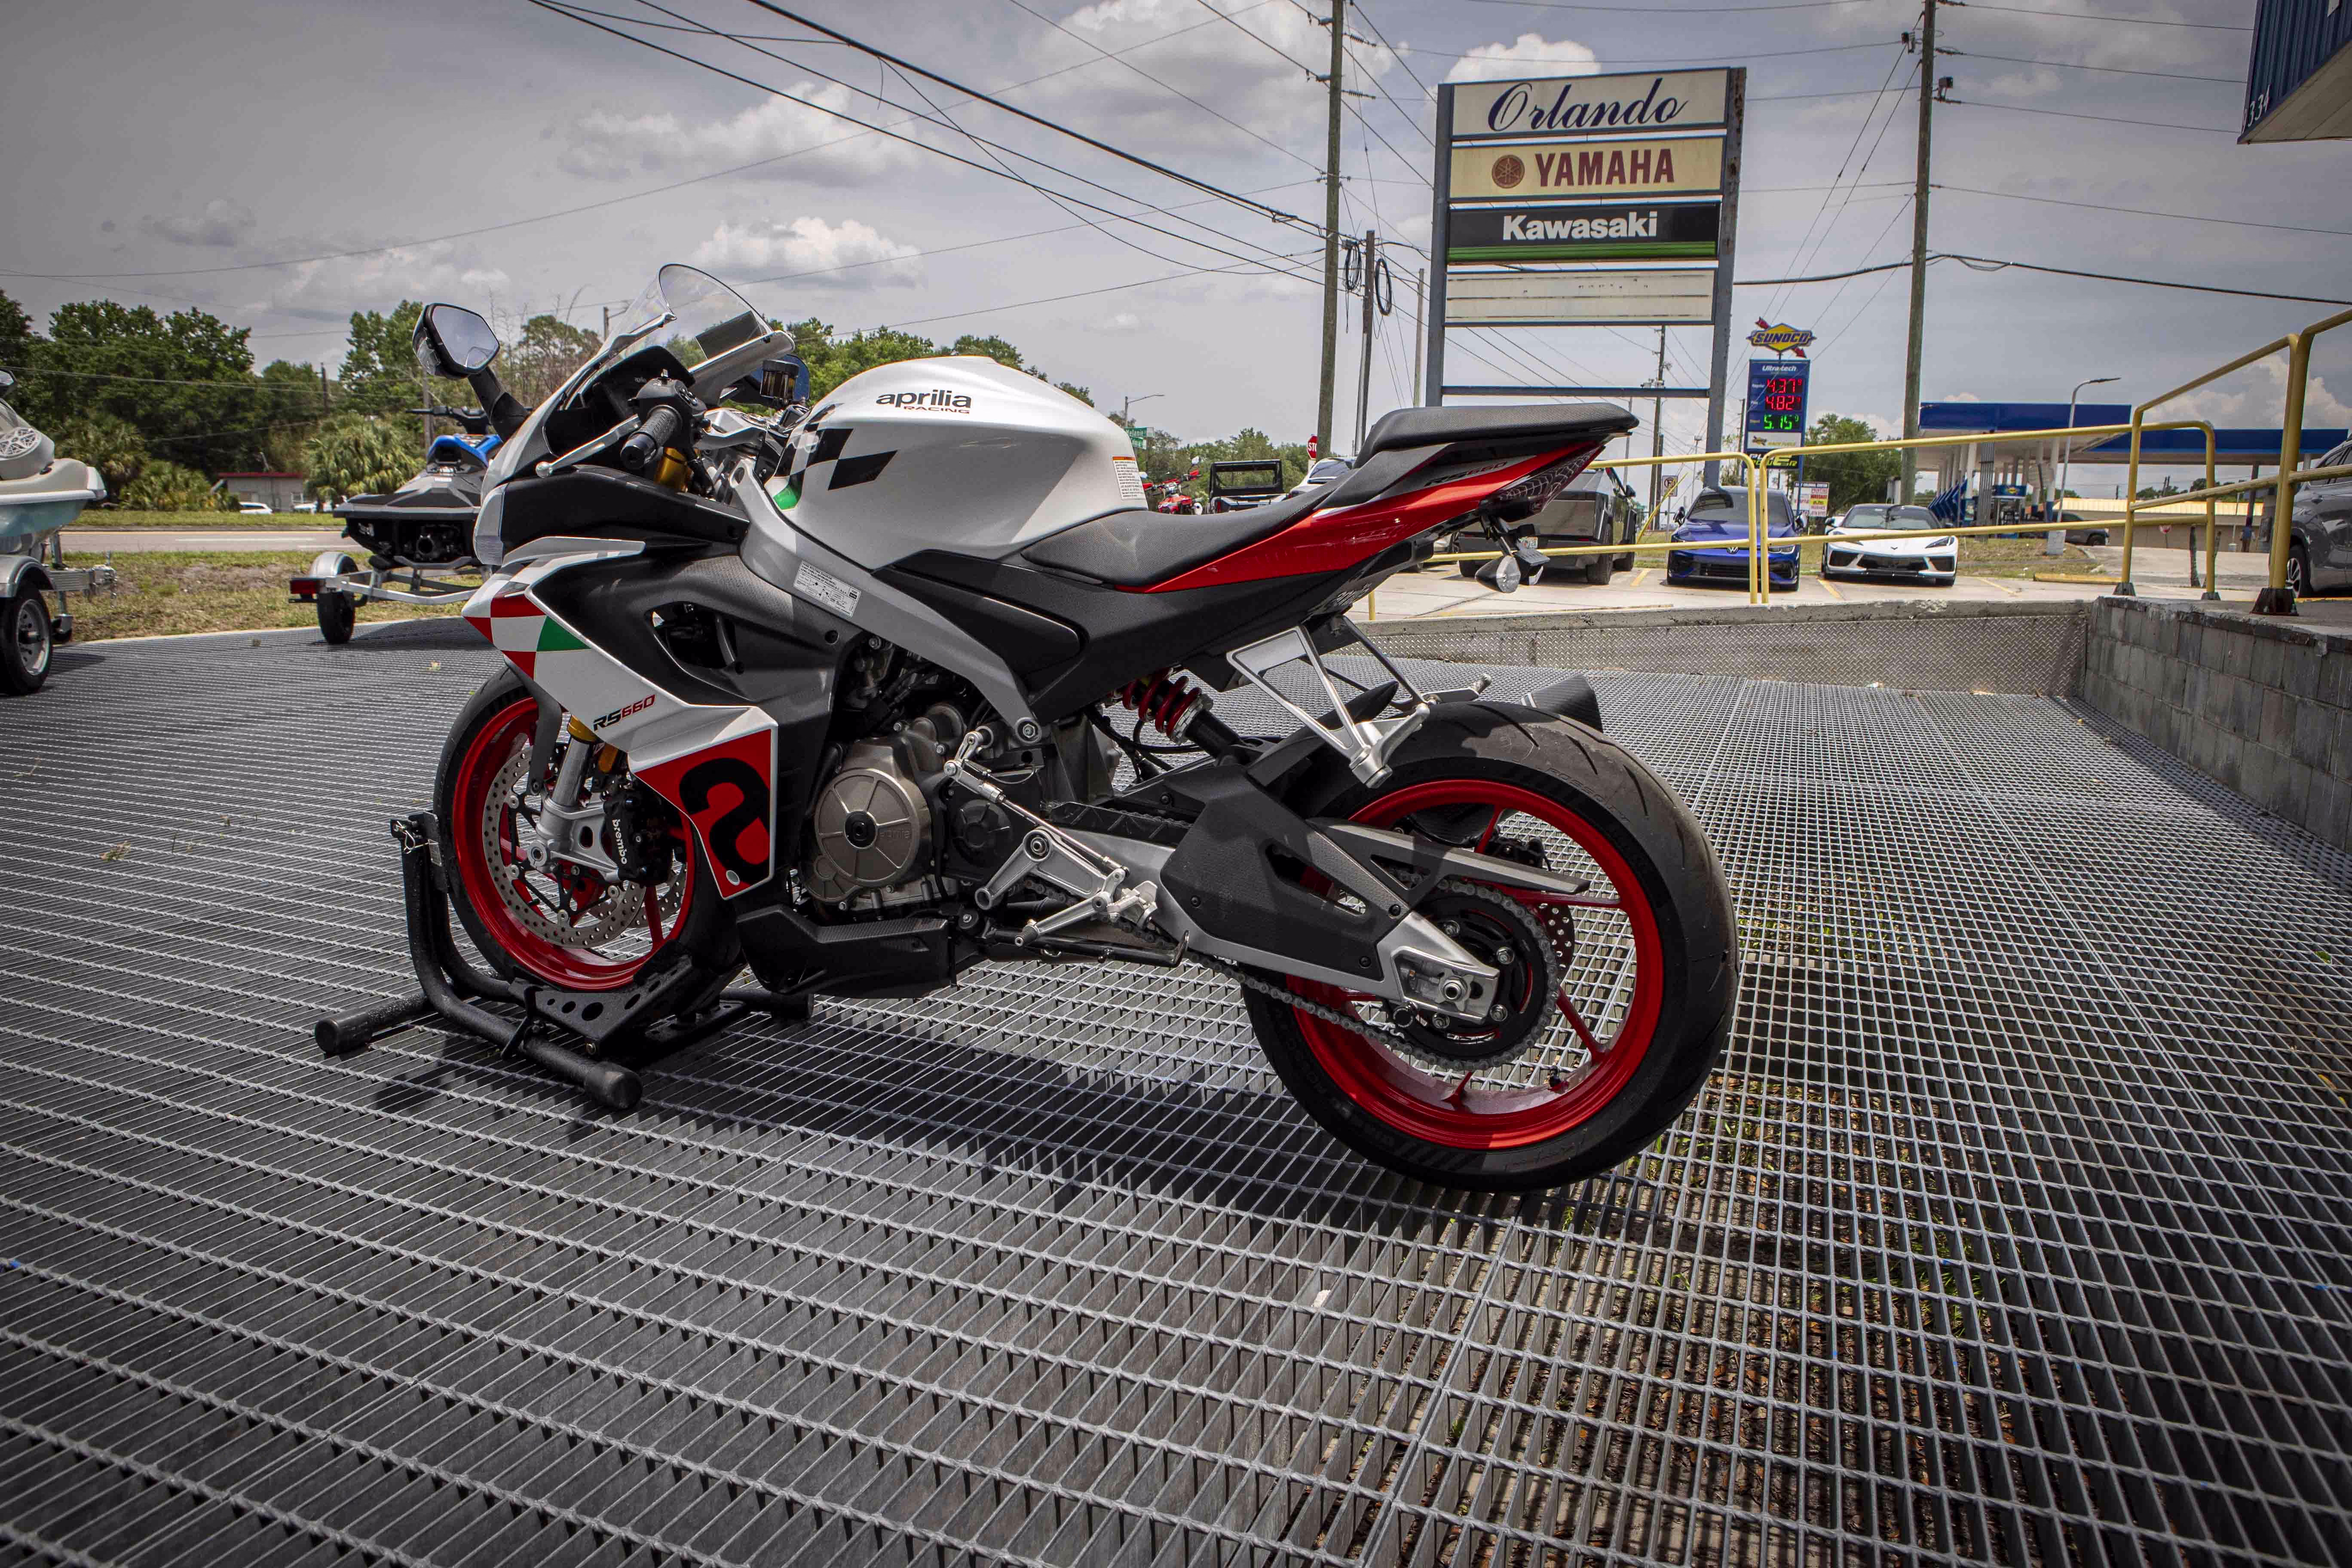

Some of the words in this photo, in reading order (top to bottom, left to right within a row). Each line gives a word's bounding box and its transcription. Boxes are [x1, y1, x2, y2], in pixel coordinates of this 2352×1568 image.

[1488, 77, 1688, 131] Orlando
[1535, 148, 1674, 187] YAMAHA
[1503, 211, 1657, 240] Kawasaki
[1754, 333, 1809, 343] SUNOCO
[876, 389, 971, 408] aprilia
[612, 818, 627, 864] brembo
